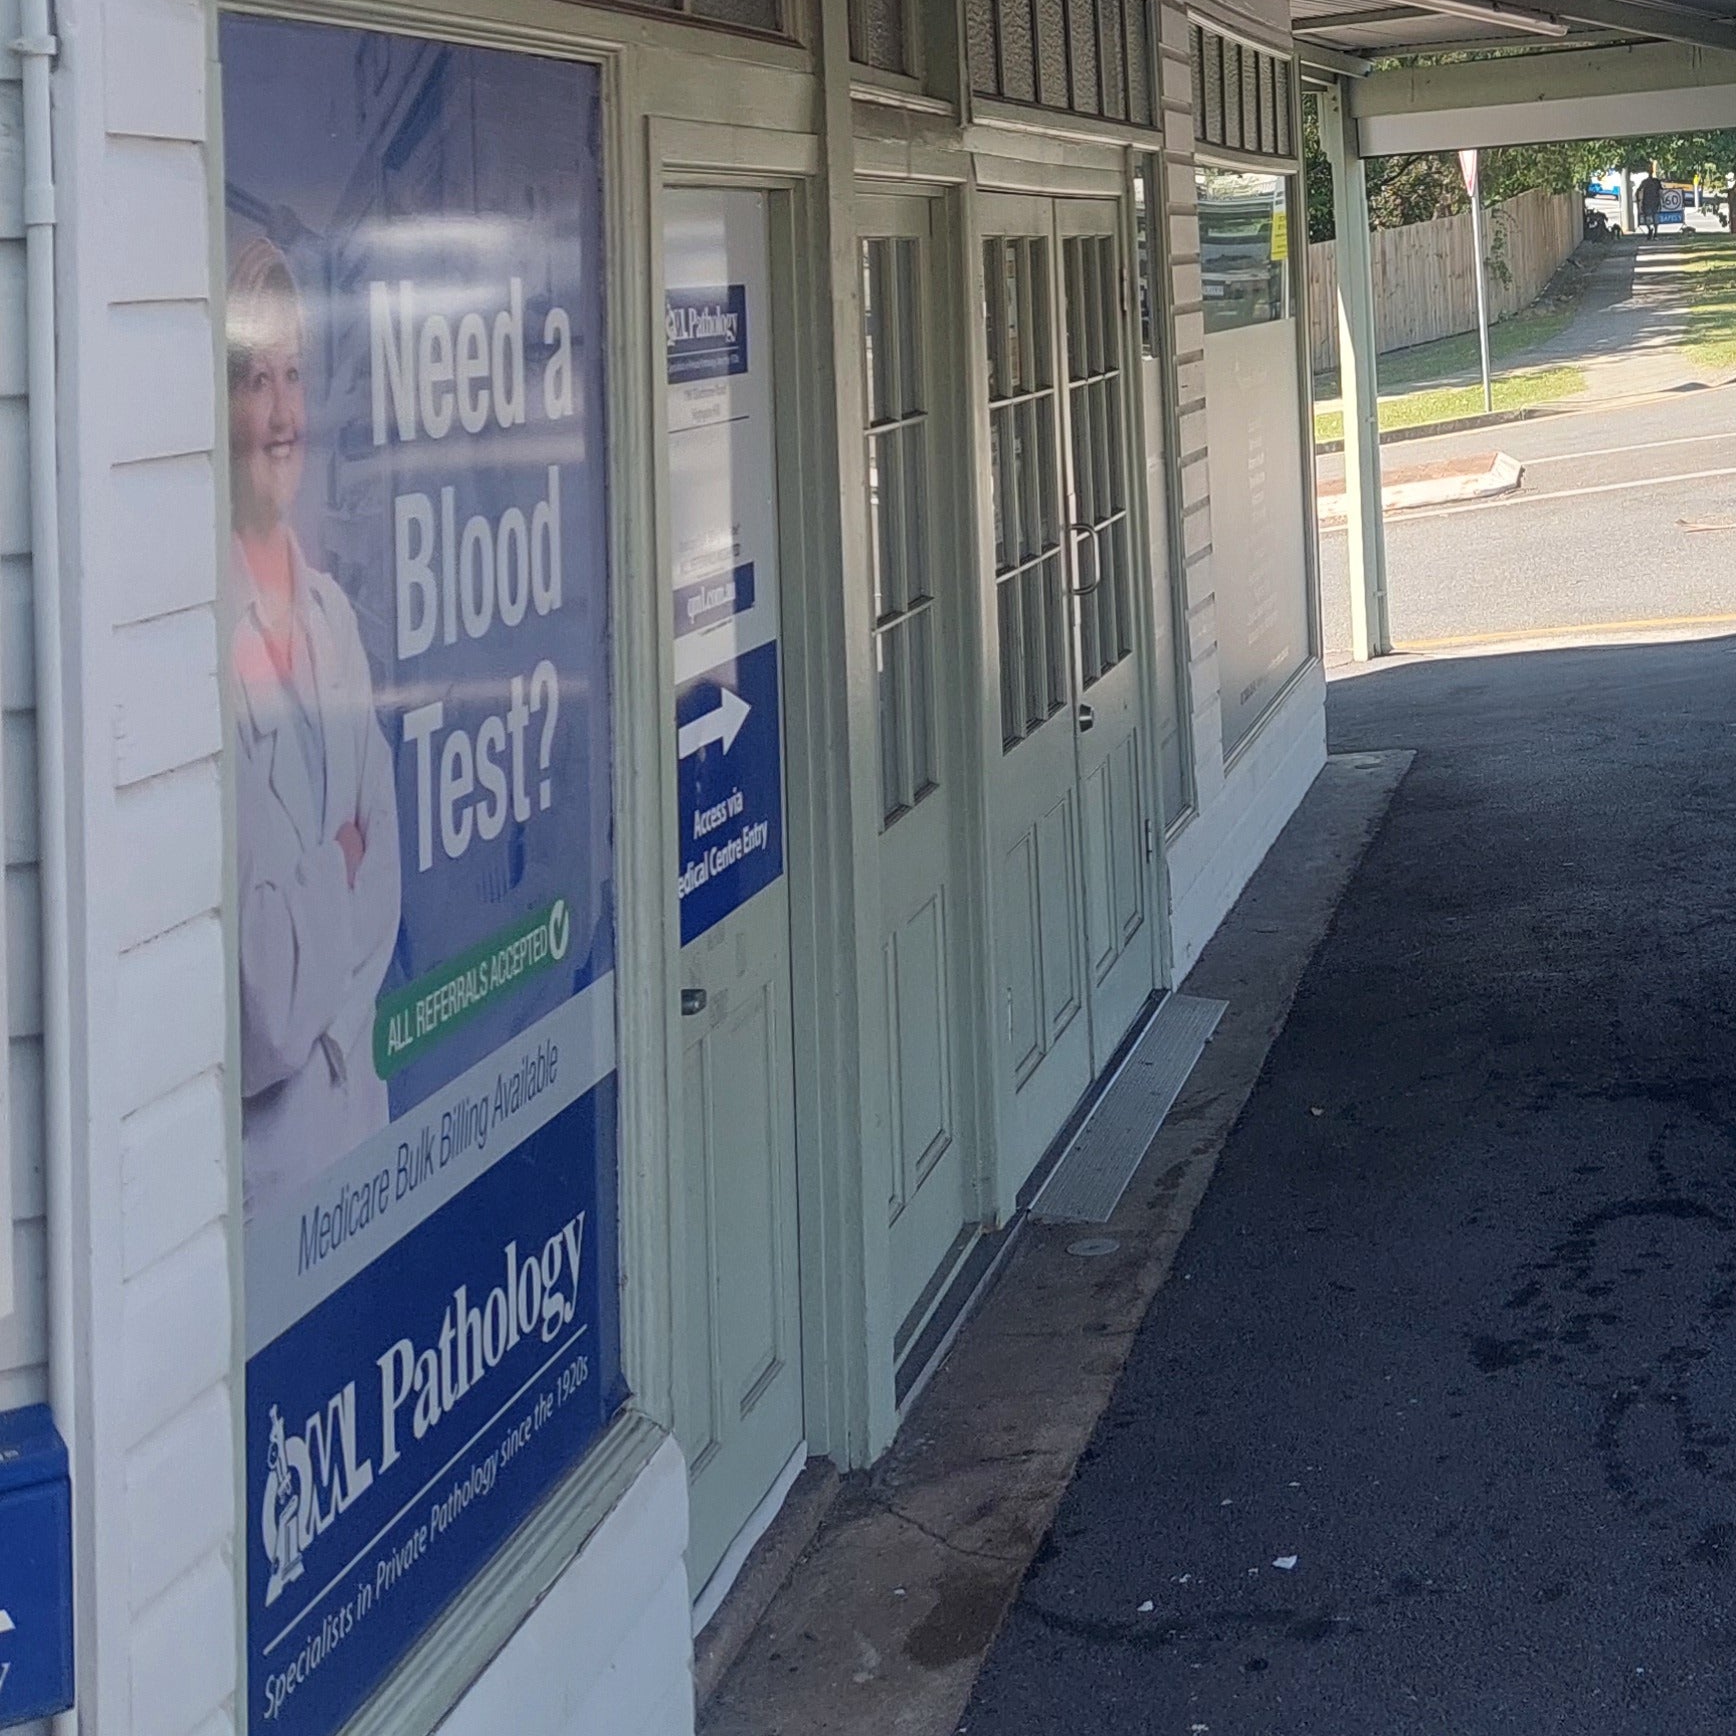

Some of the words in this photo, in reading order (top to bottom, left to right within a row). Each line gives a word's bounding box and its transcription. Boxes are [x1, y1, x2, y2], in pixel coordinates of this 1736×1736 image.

[1665, 195, 1679, 206] 60
[367, 276, 527, 448] Need
[543, 304, 576, 421] a
[688, 305, 739, 344] Pathology
[394, 465, 563, 663] Blood
[402, 658, 561, 875] Test?
[693, 798, 728, 841] Access
[727, 786, 744, 818] via
[678, 850, 710, 899] edical
[709, 837, 743, 877] Centre
[742, 819, 769, 851] Entry
[387, 1009, 414, 1057] ALL
[415, 960, 490, 1038] REFERRALS
[489, 924, 549, 992] ACCEPTED
[297, 1168, 391, 1277] Medicare
[395, 1124, 437, 1202] Bulk
[439, 1093, 489, 1170] Billing
[491, 1037, 559, 1130] Available
[376, 1209, 586, 1475] Pathology
[263, 1601, 354, 1720] Specialists
[356, 1582, 373, 1621] in
[375, 1523, 428, 1601] Private
[429, 1447, 500, 1543] Pathology
[500, 1416, 532, 1468] since
[533, 1392, 554, 1432] the
[555, 1353, 589, 1407] 1920s
